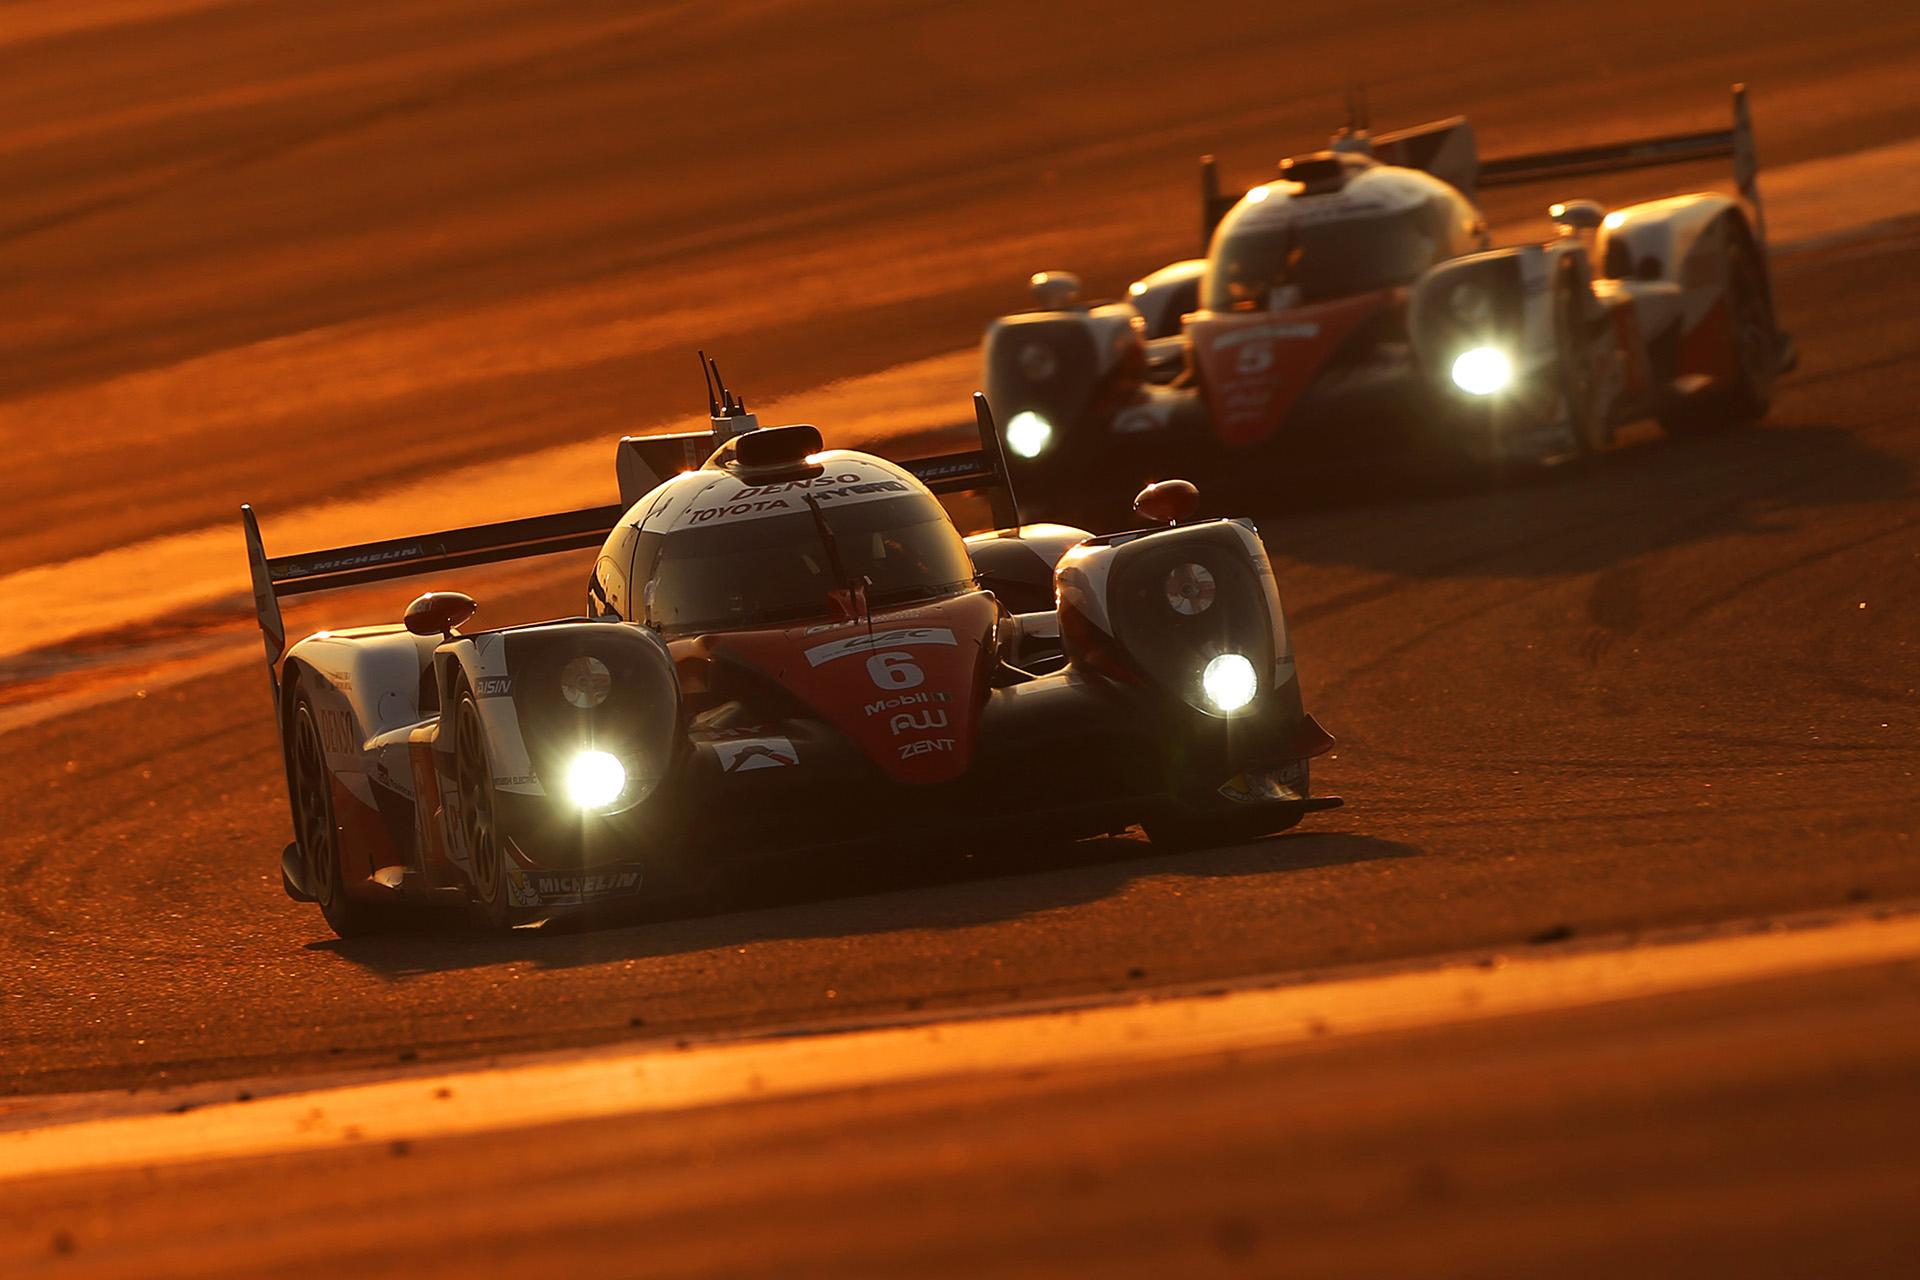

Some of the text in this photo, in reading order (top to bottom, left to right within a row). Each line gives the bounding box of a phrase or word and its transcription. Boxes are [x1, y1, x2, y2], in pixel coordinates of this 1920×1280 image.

[1236, 341, 1275, 374] 5
[729, 474, 862, 502] DENSO
[689, 499, 790, 525] TOYOTA
[312, 547, 418, 570] MICHELIN
[866, 651, 925, 690] 6
[478, 680, 512, 694] AISIN
[864, 693, 929, 717] Mobil
[898, 739, 956, 760] ZENT
[539, 872, 638, 893] MICHELIN
